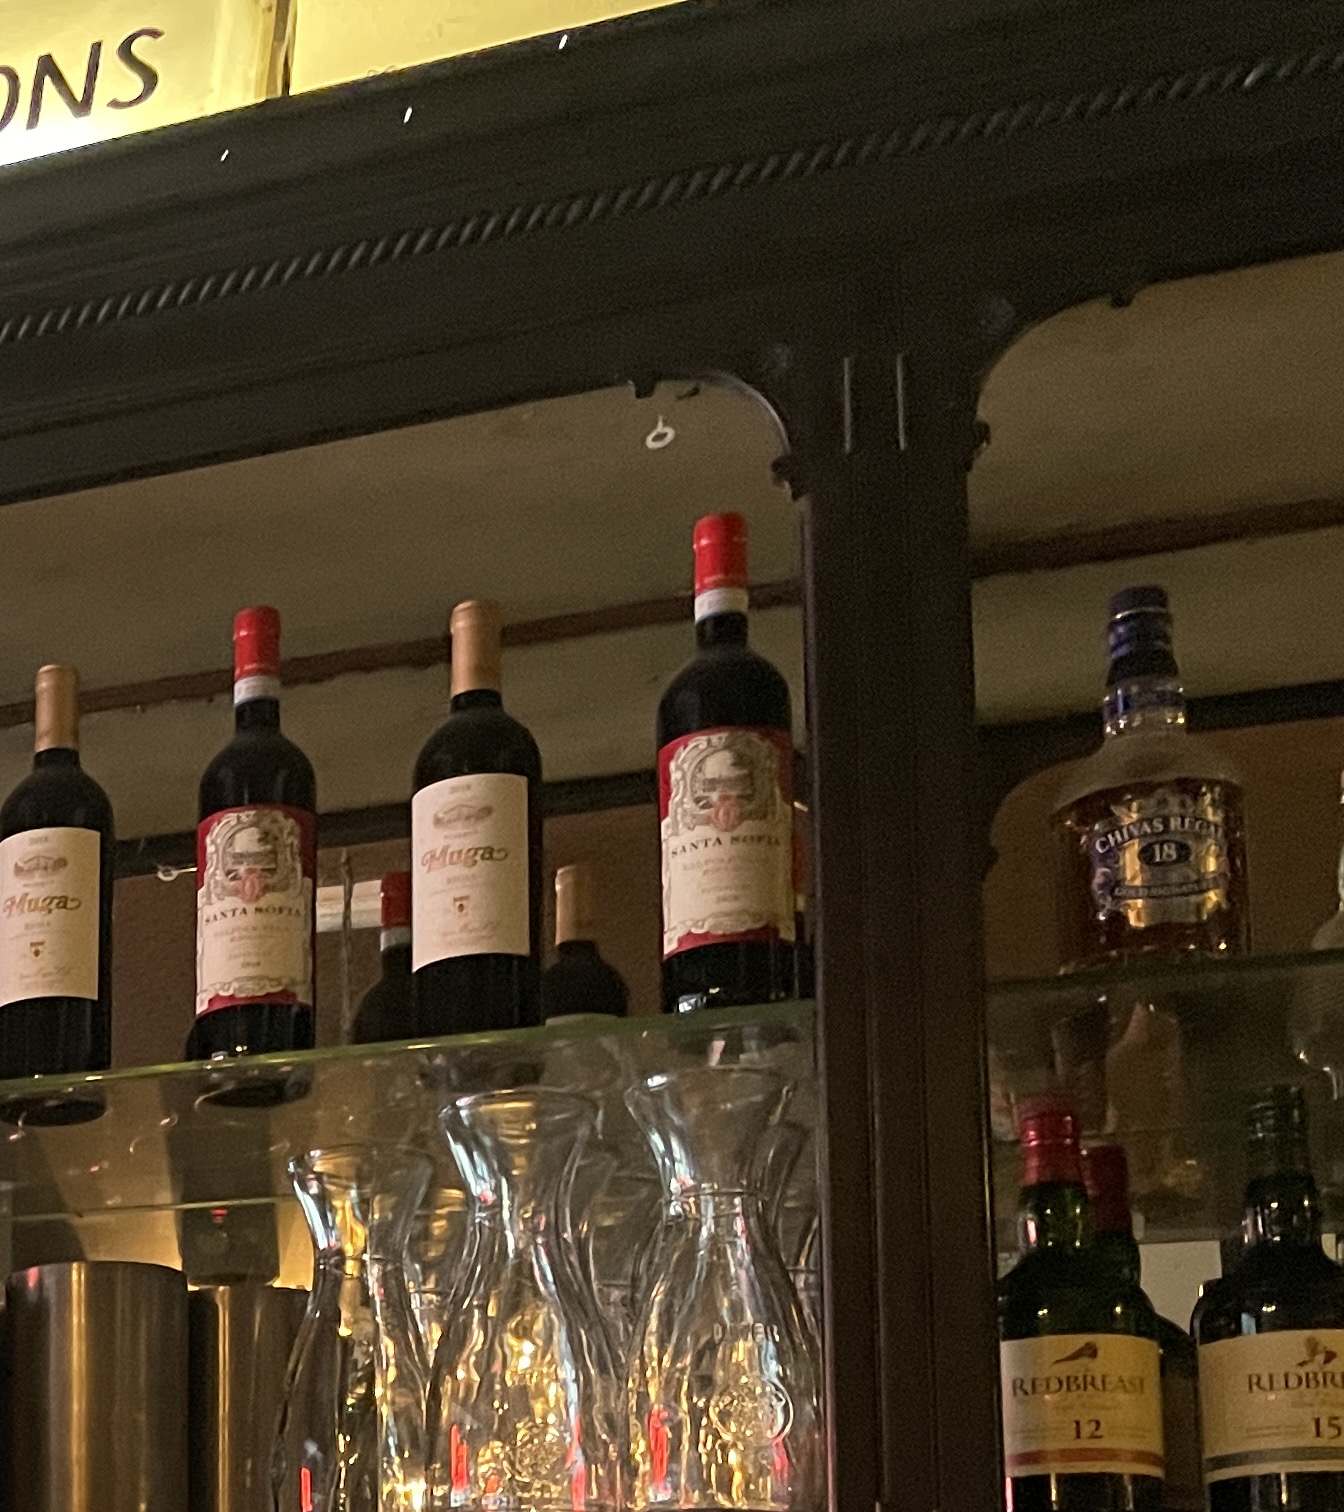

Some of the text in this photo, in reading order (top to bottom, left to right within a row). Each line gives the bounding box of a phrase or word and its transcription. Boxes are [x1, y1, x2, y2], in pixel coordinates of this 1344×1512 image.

[671, 834, 782, 859] SANTA SOFIA
[1095, 819, 1164, 855] CHIVAS
[421, 843, 508, 875] Muga
[1152, 843, 1179, 866] 18
[2, 893, 82, 919] Muga
[203, 906, 302, 925] SANTA SOFIA
[1071, 1419, 1104, 1441] 12
[1312, 1417, 1343, 1439] 15
